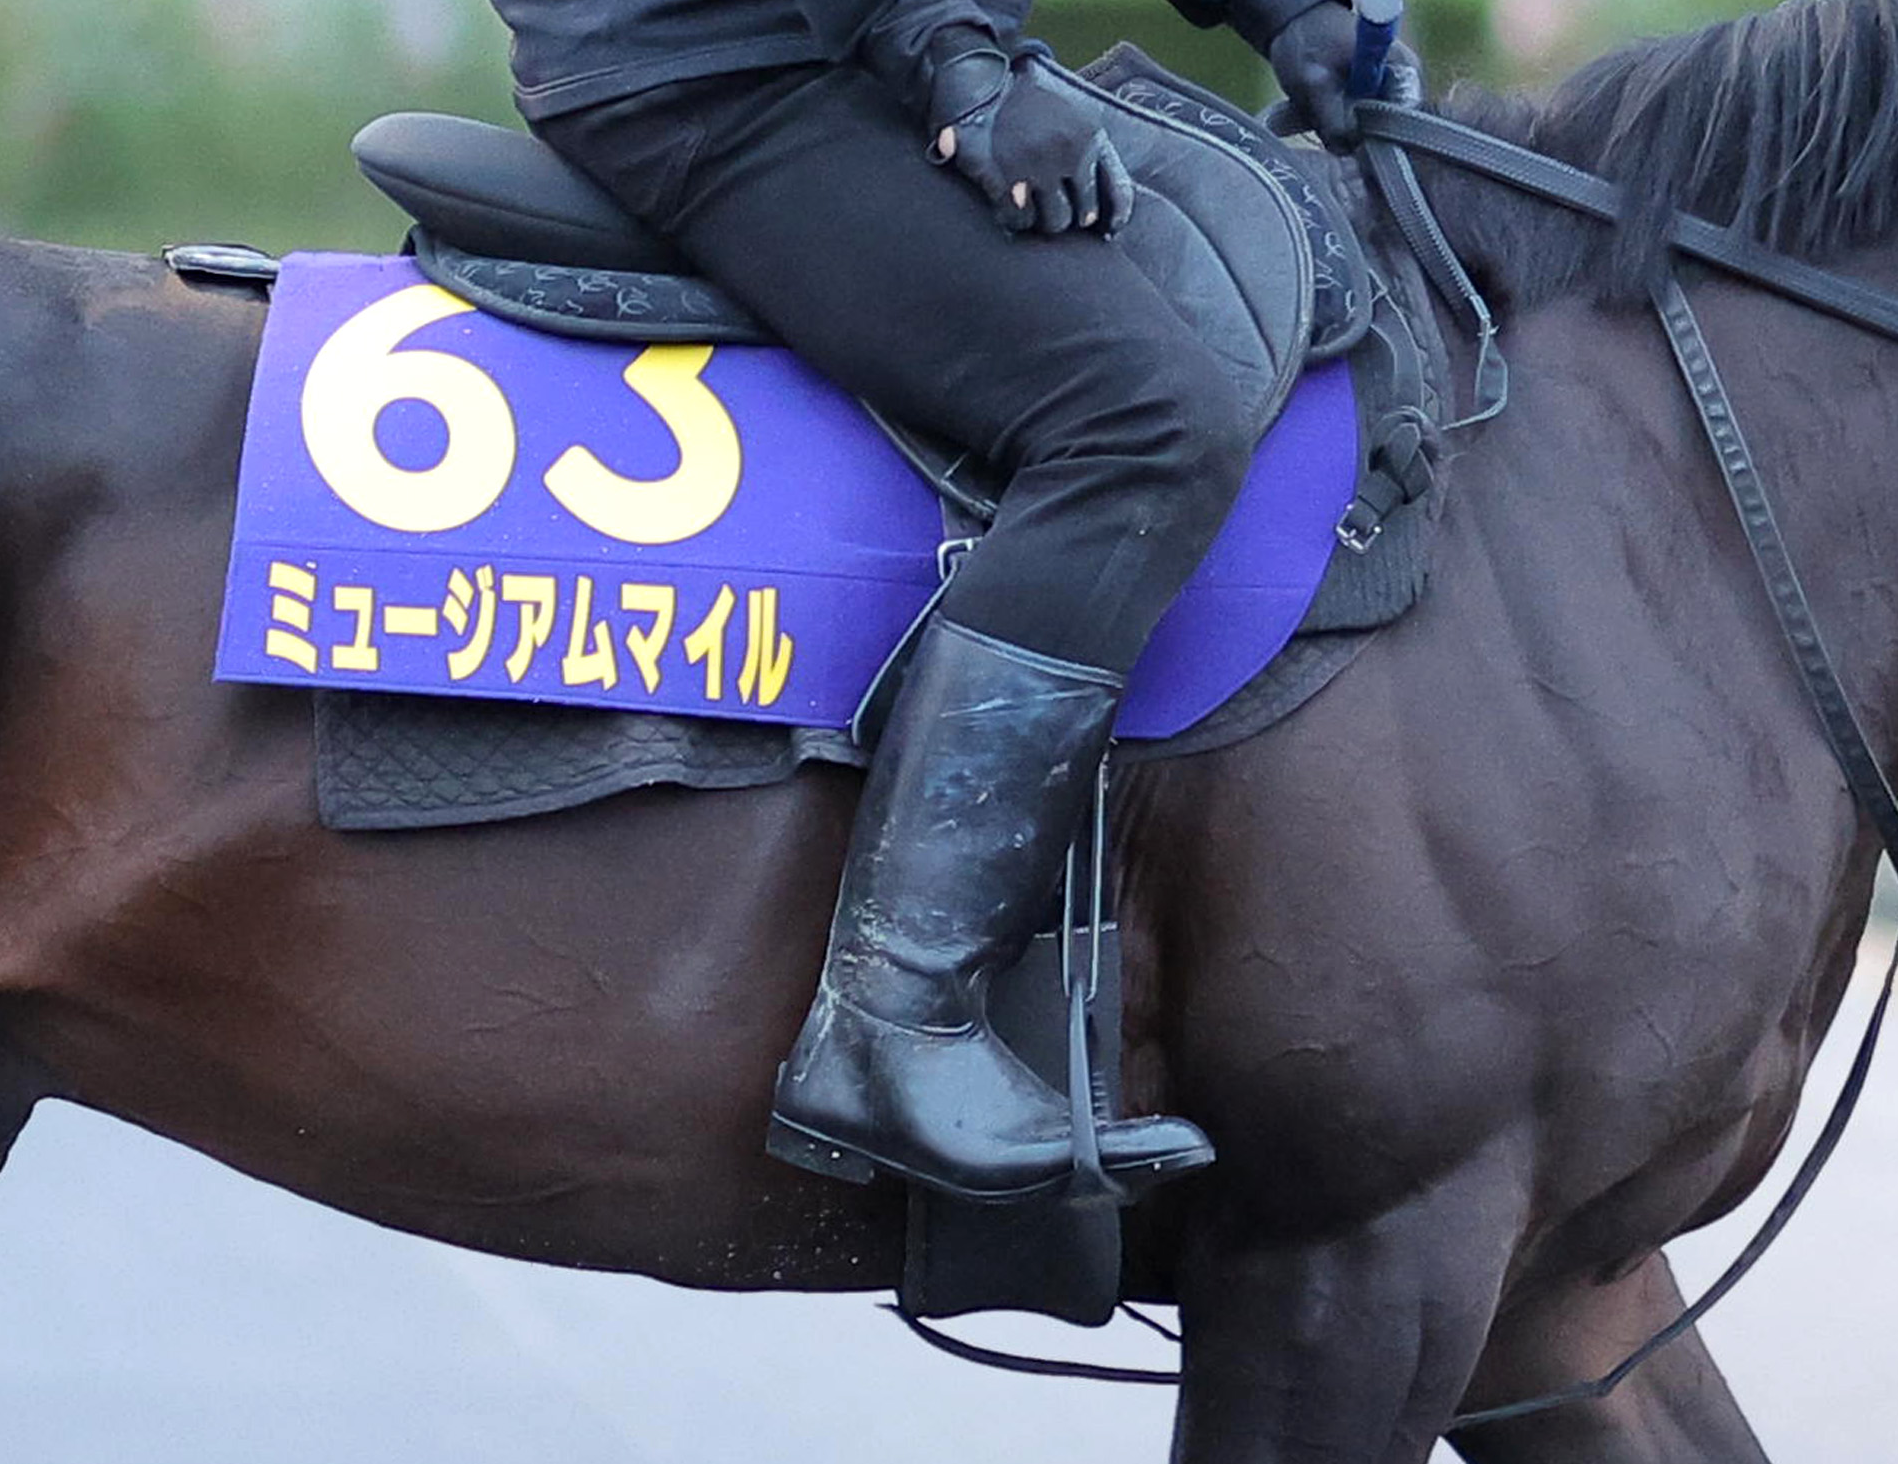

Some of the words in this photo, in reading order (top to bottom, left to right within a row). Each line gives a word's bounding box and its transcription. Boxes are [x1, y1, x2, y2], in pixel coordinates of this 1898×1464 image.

[300, 282, 743, 546] 63
[264, 561, 795, 708] ミュージアムマイル
